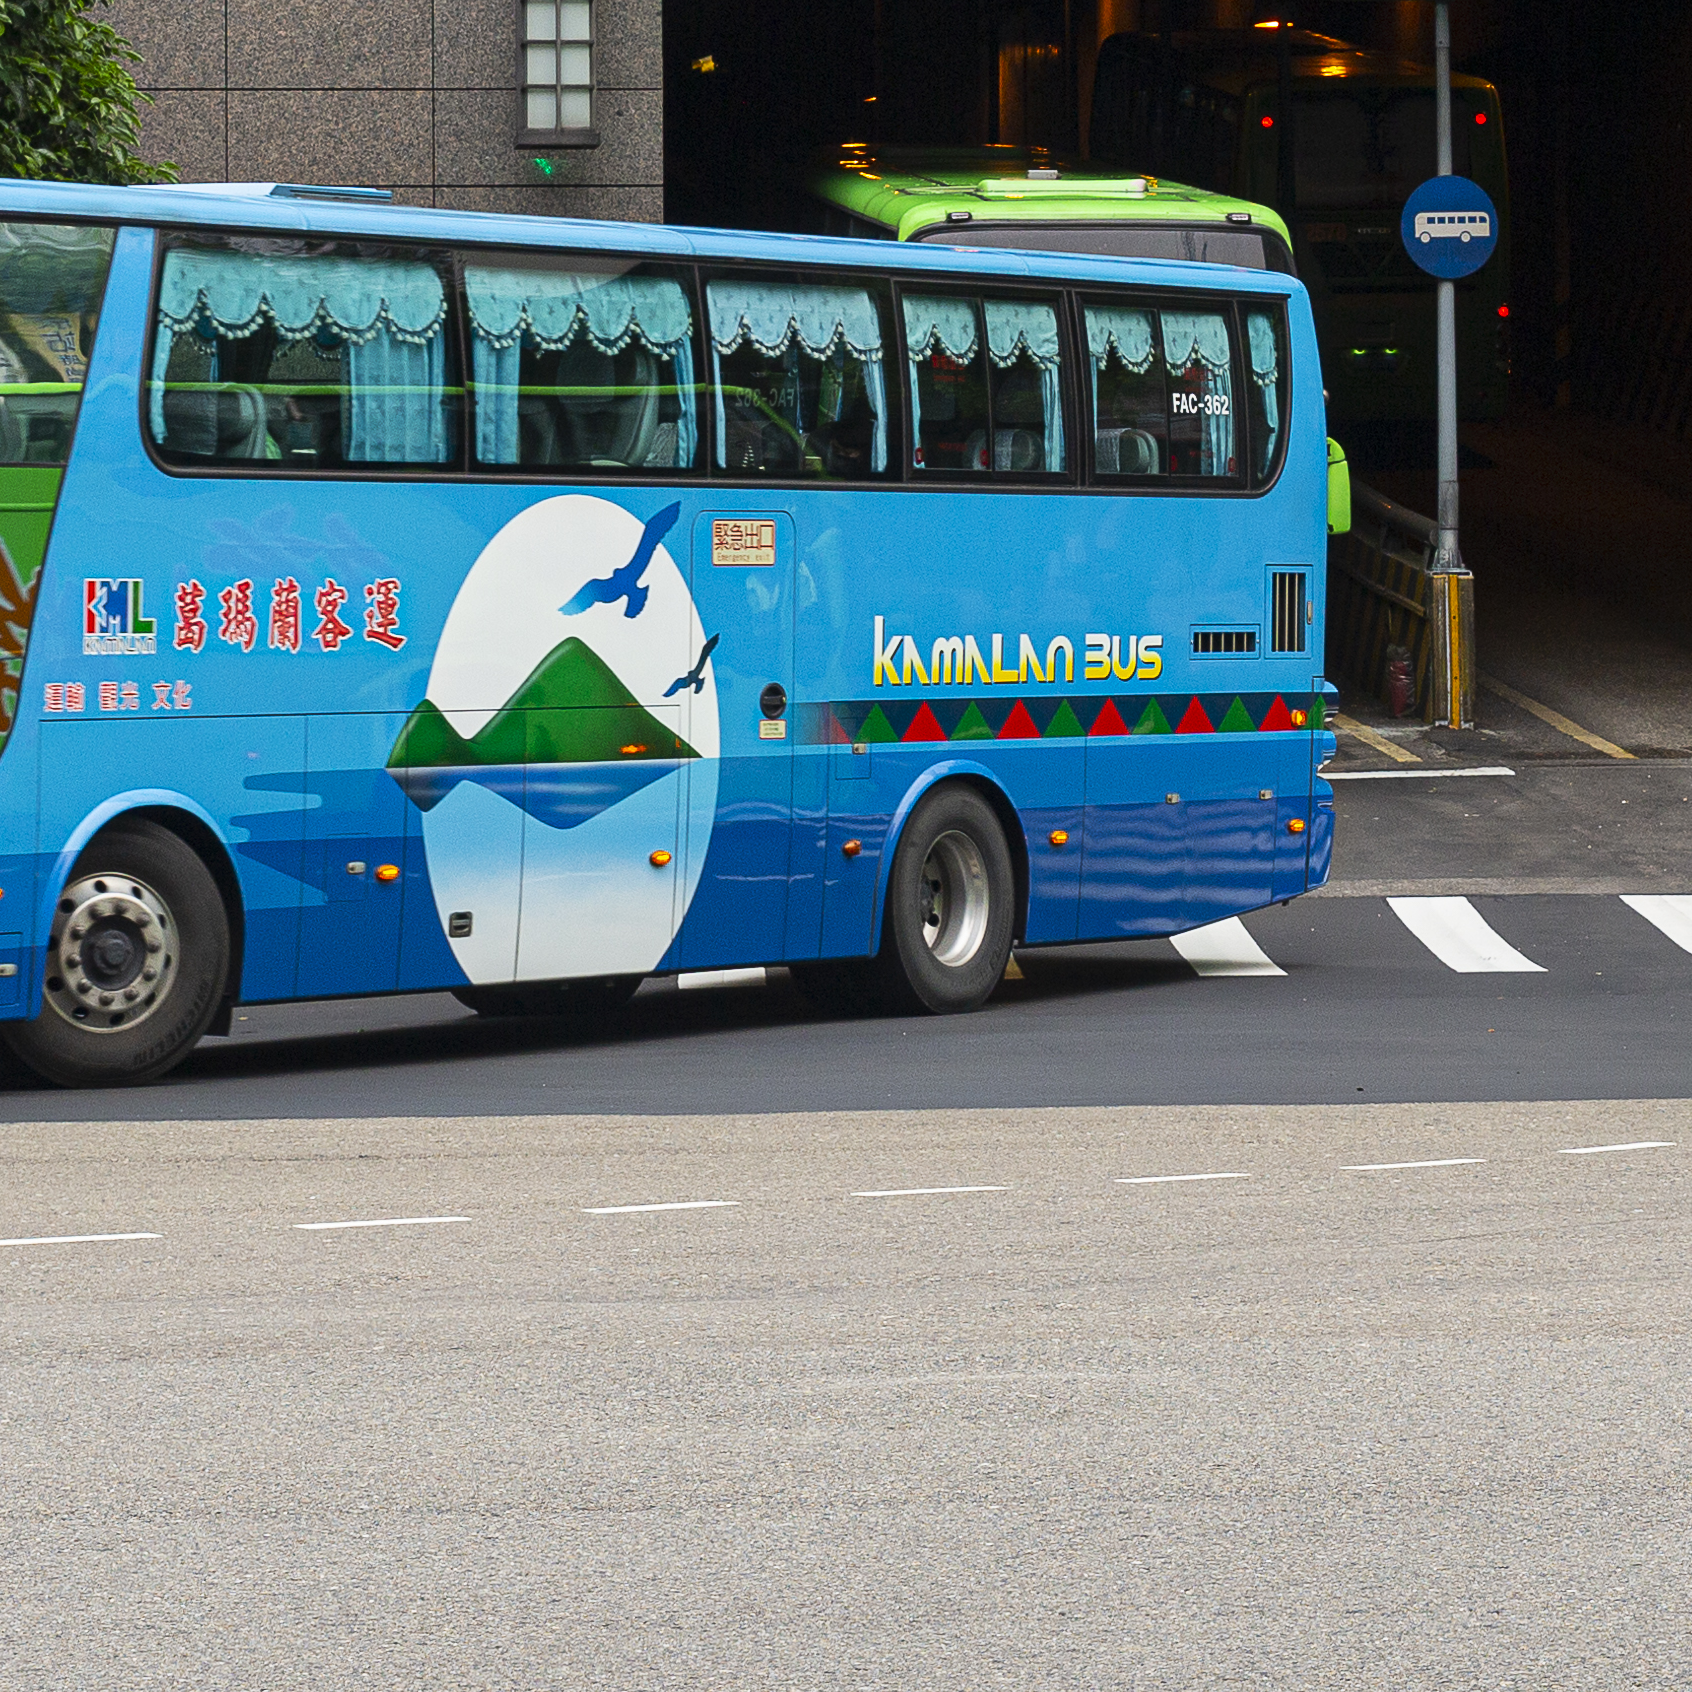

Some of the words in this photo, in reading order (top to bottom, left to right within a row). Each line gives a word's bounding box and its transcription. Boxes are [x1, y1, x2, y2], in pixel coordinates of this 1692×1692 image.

[1172, 392, 1230, 416] FAC-362
[714, 522, 775, 551] 緊急出口
[716, 552, 750, 562] Emergency
[83, 578, 157, 636] KML
[174, 576, 408, 654] 葛瑪蘭客運
[1083, 633, 1165, 682] BUS
[43, 682, 85, 712] 運輸
[99, 681, 139, 710] 觀光
[152, 680, 192, 710] 文化
